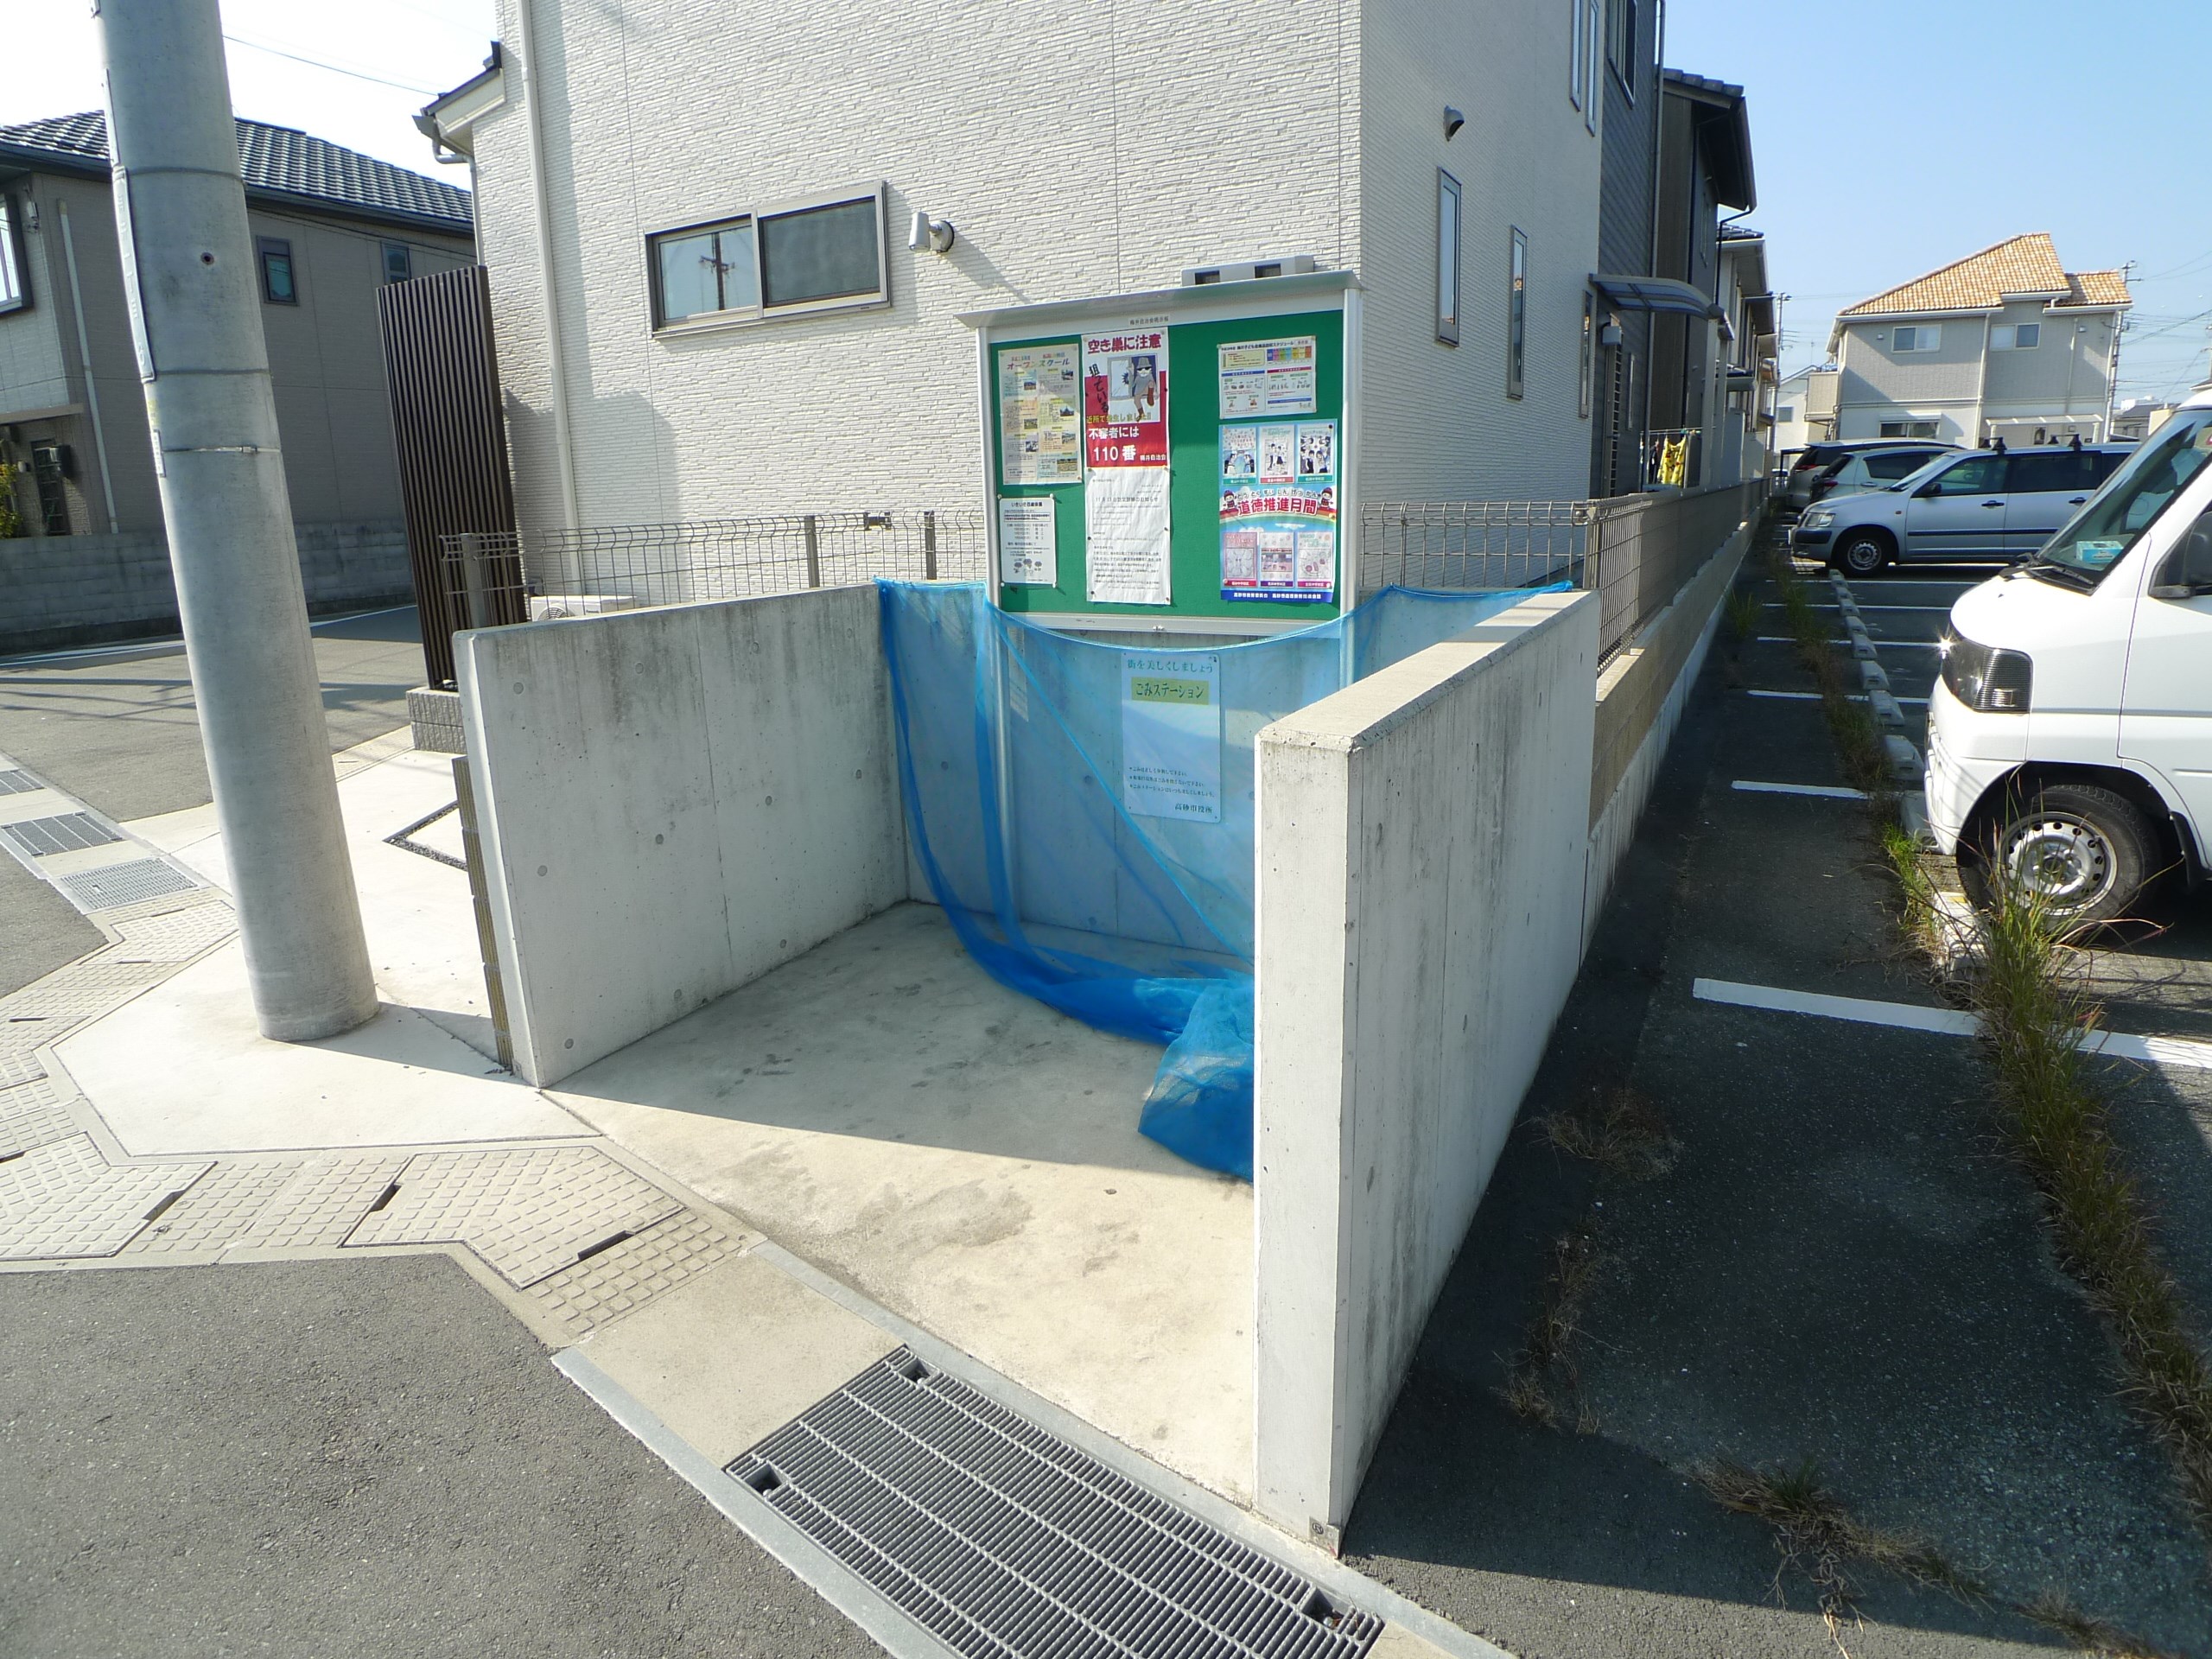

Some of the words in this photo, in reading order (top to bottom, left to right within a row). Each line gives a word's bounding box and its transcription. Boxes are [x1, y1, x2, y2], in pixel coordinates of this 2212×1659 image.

[1088, 333, 1161, 354] 空き巣に注意
[1088, 426, 1140, 440] 不審者には
[1237, 497, 1318, 516] 道徳推進月間
[1127, 659, 1213, 674] 街を美しくしましょう
[1135, 682, 1205, 699] ごみステーション
[1174, 803, 1213, 814] 高砂市役所
